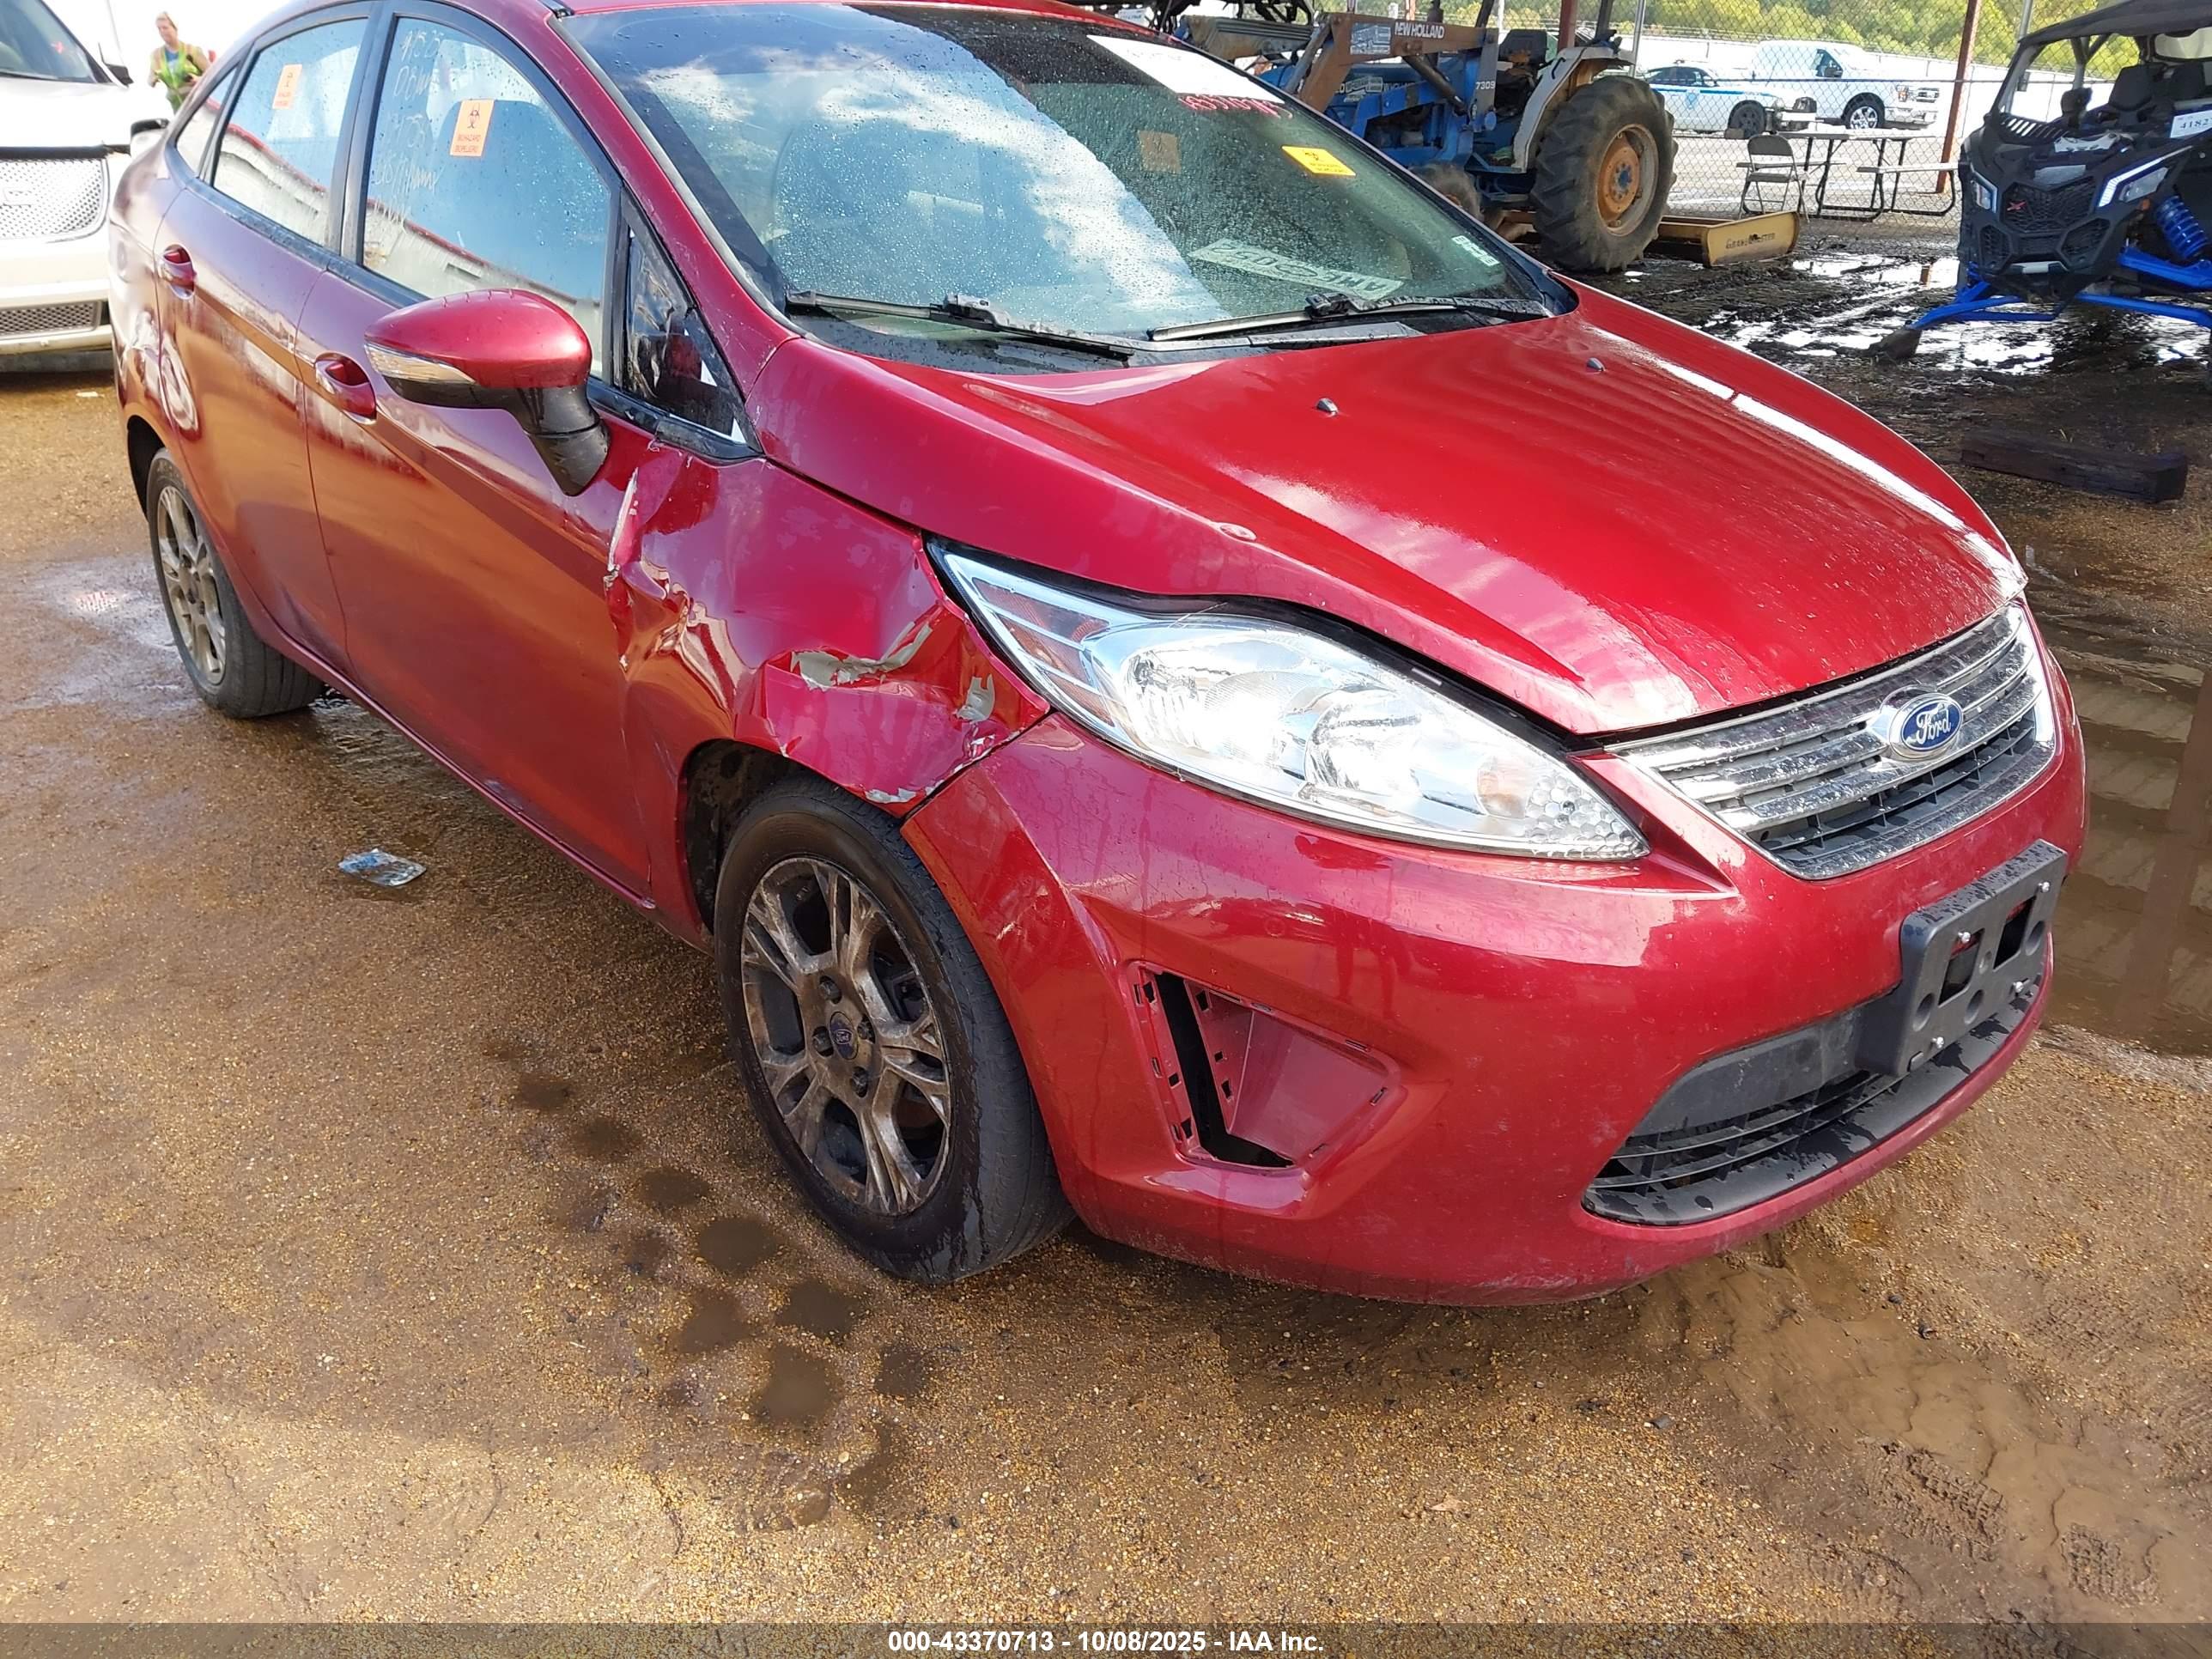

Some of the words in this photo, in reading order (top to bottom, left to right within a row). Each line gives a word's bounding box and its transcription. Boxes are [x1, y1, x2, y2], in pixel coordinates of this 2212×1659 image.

[1395, 21, 1411, 36] NEW
[1411, 23, 1444, 39] HOLLAND
[1475, 81, 1495, 90] 7309
[2179, 117, 2212, 129] 4182
[1916, 704, 1952, 744] Ford
